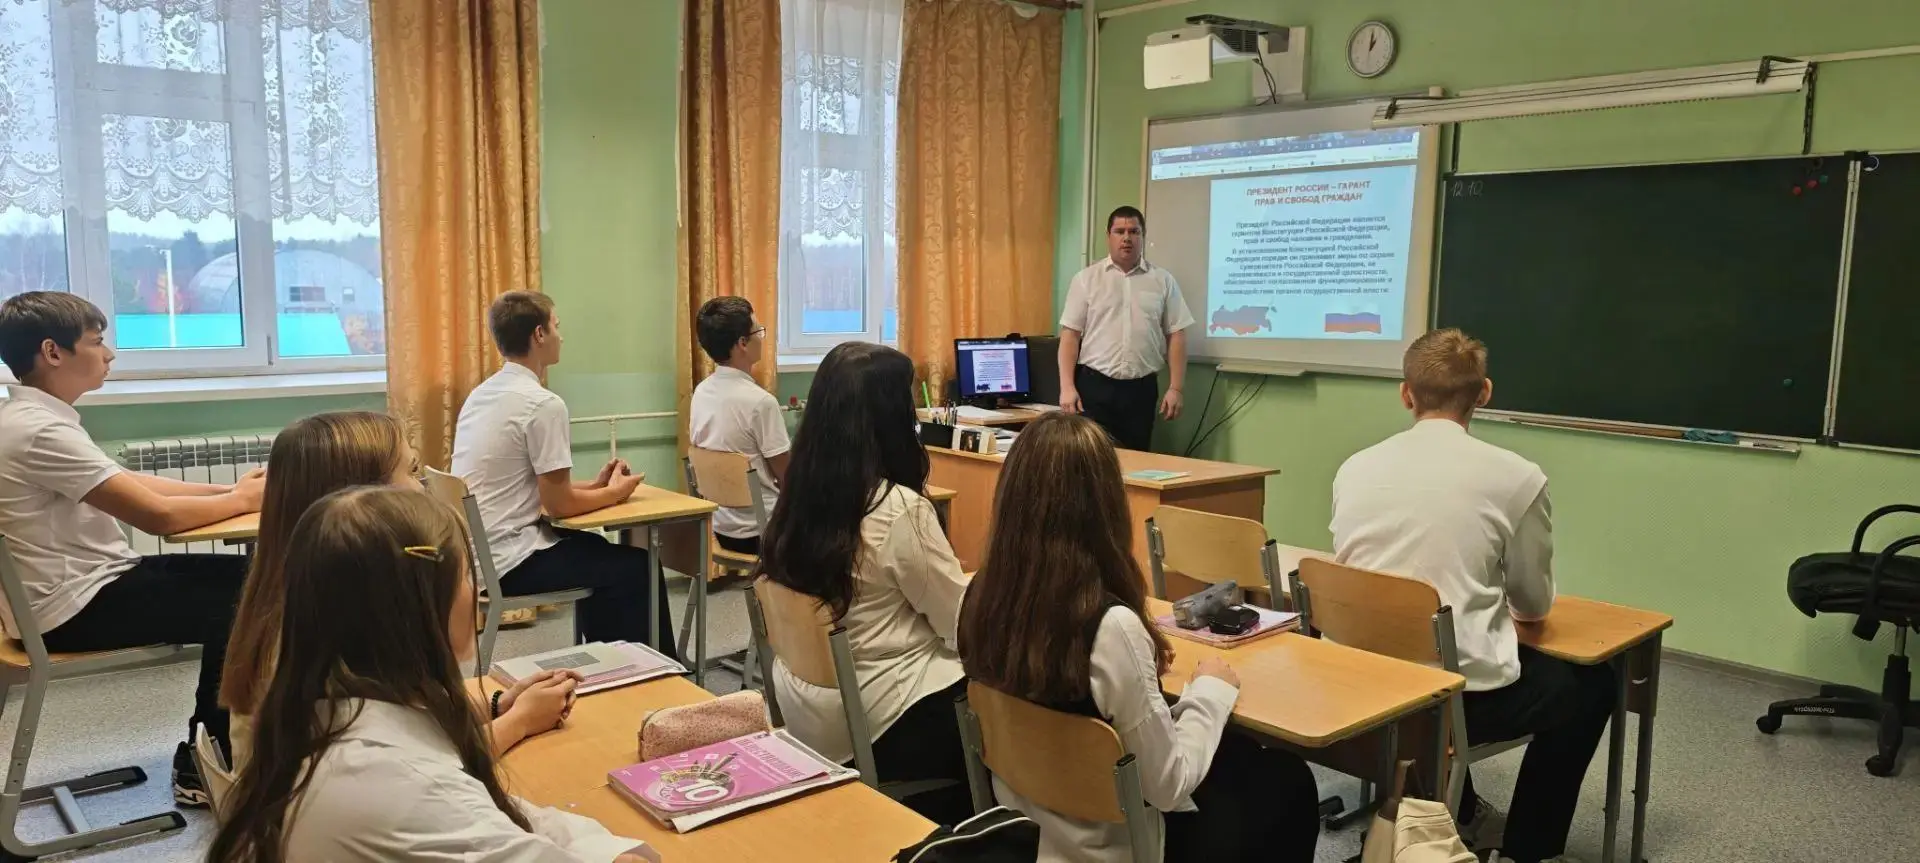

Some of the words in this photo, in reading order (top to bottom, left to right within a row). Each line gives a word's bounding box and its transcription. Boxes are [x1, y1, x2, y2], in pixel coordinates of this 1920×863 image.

[1247, 186, 1292, 196] ПРЕЗИДЕНТ
[1295, 184, 1330, 192] РОССИИ
[1338, 181, 1371, 190] ГАРАНТ
[1255, 198, 1275, 206] ПРАВ
[1285, 195, 1320, 204] СВОБОД
[1322, 193, 1363, 202] ГРАЖДАН
[676, 778, 728, 802] 10
